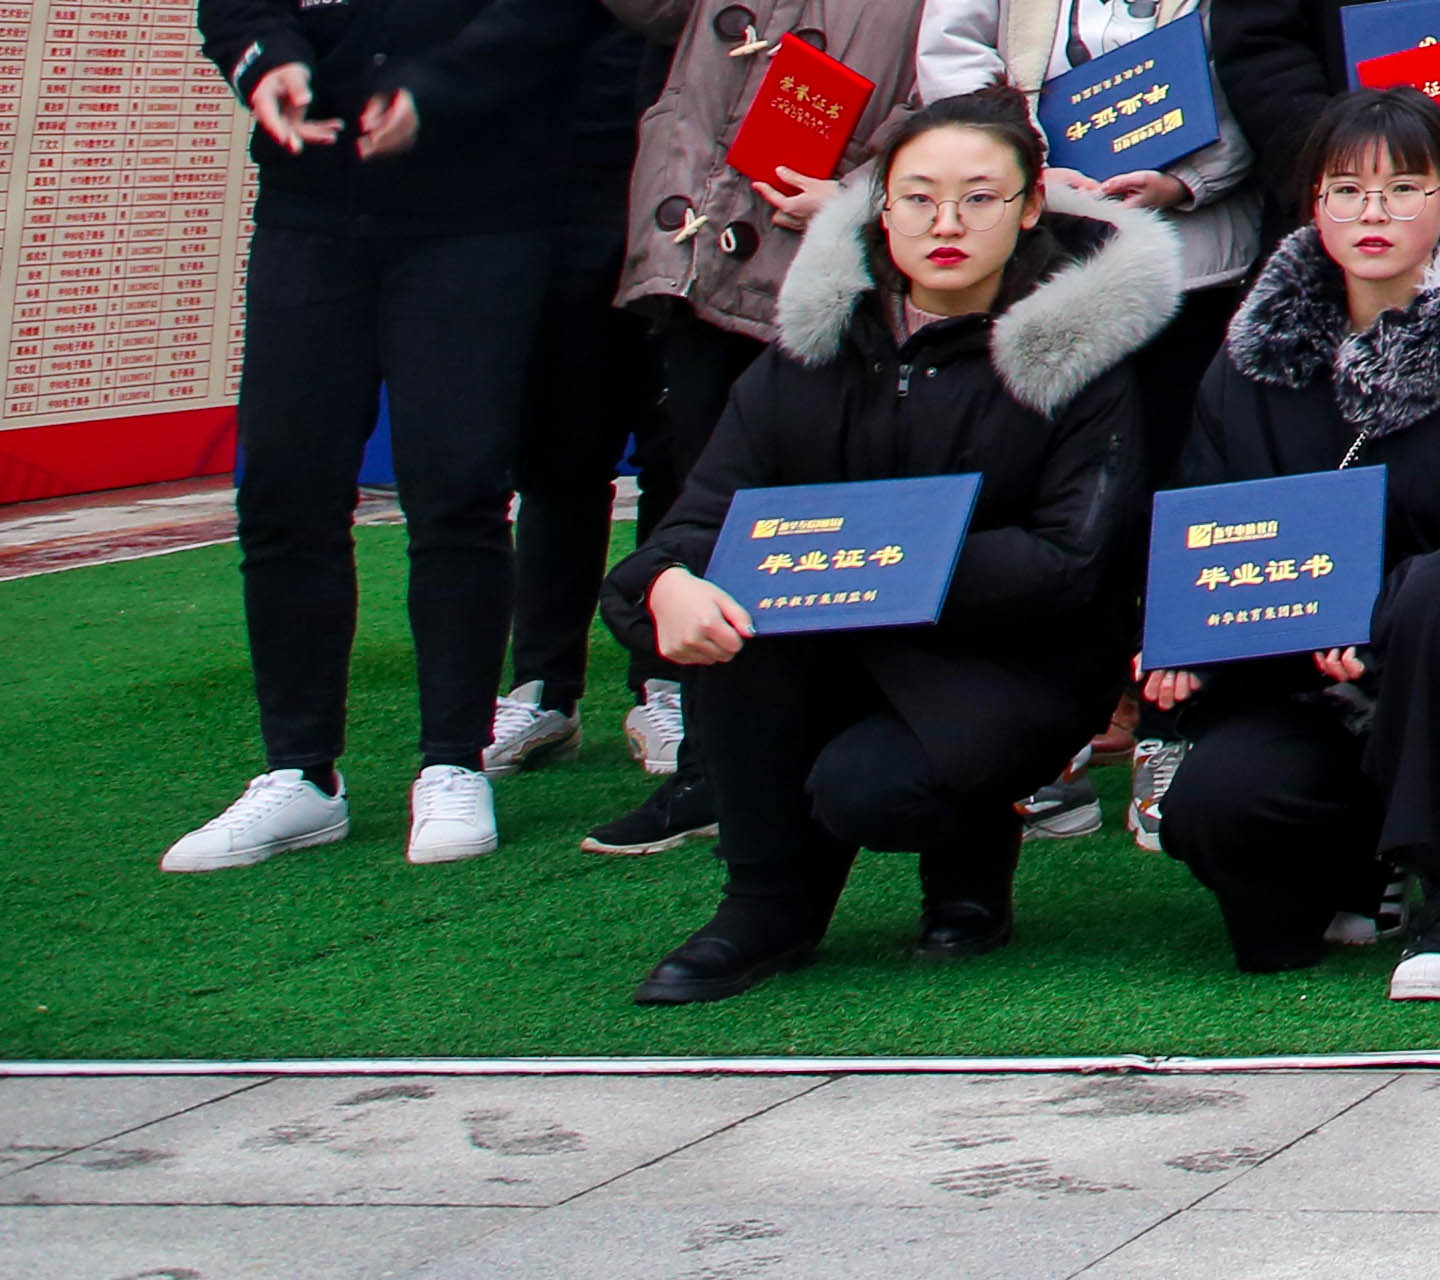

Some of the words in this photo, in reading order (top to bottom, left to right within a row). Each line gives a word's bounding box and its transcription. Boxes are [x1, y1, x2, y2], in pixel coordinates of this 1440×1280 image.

[1066, 84, 1170, 141] 毕业证书
[757, 545, 904, 575] 毕业证书
[1195, 554, 1335, 591] 毕业证书
[759, 589, 878, 609] 新华教育集团监制
[1206, 601, 1319, 626] 新华教育集团监制
